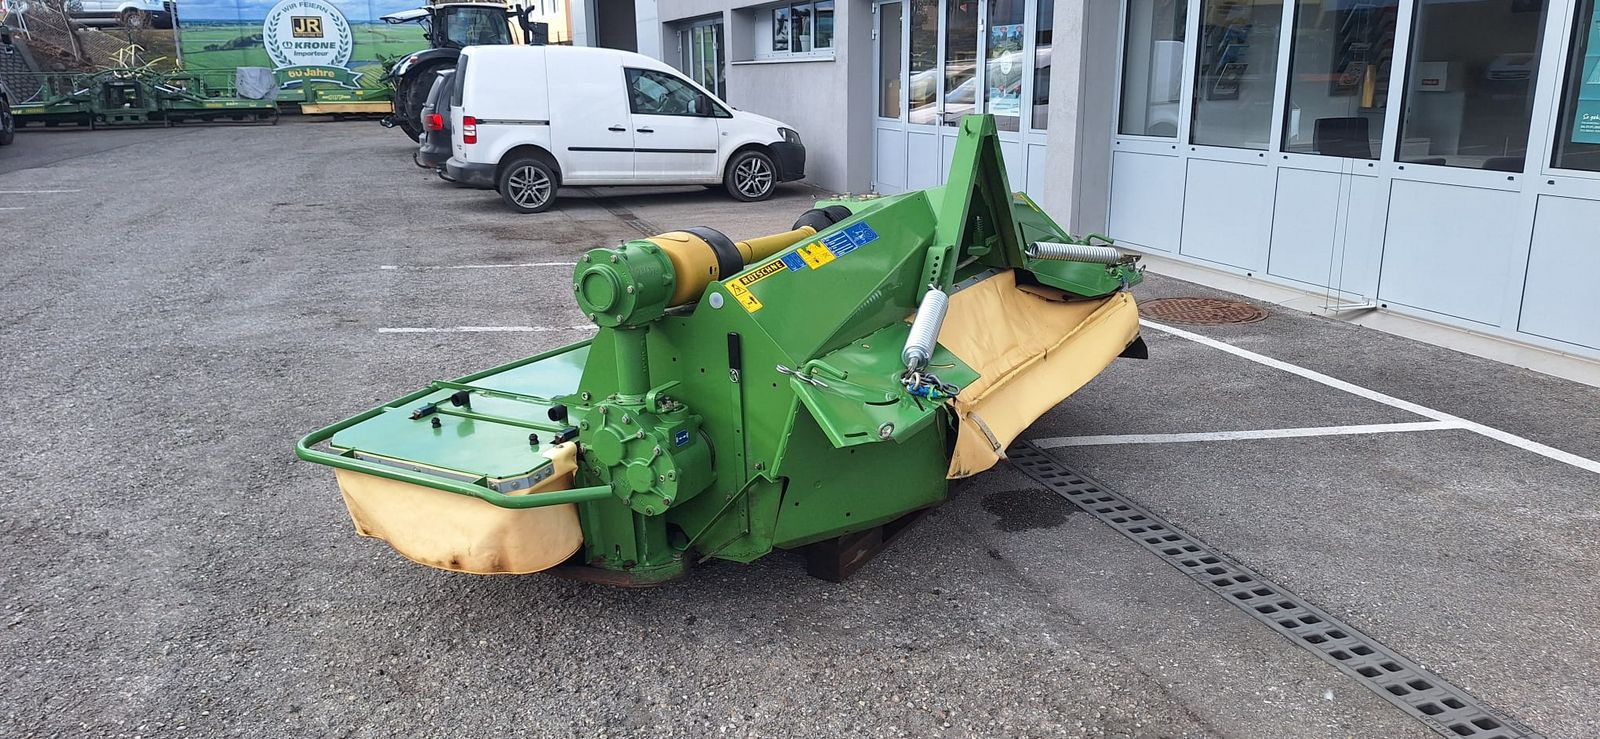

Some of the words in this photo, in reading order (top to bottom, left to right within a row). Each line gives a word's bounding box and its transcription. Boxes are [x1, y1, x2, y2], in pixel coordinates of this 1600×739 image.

[282, 2, 297, 13] WIR
[299, 2, 328, 14] FEIERN
[295, 18, 320, 32] JR
[295, 41, 336, 49] KRONE
[288, 70, 303, 78] 60
[303, 68, 335, 78] Jahre
[740, 260, 783, 286] ROTSCHNE
